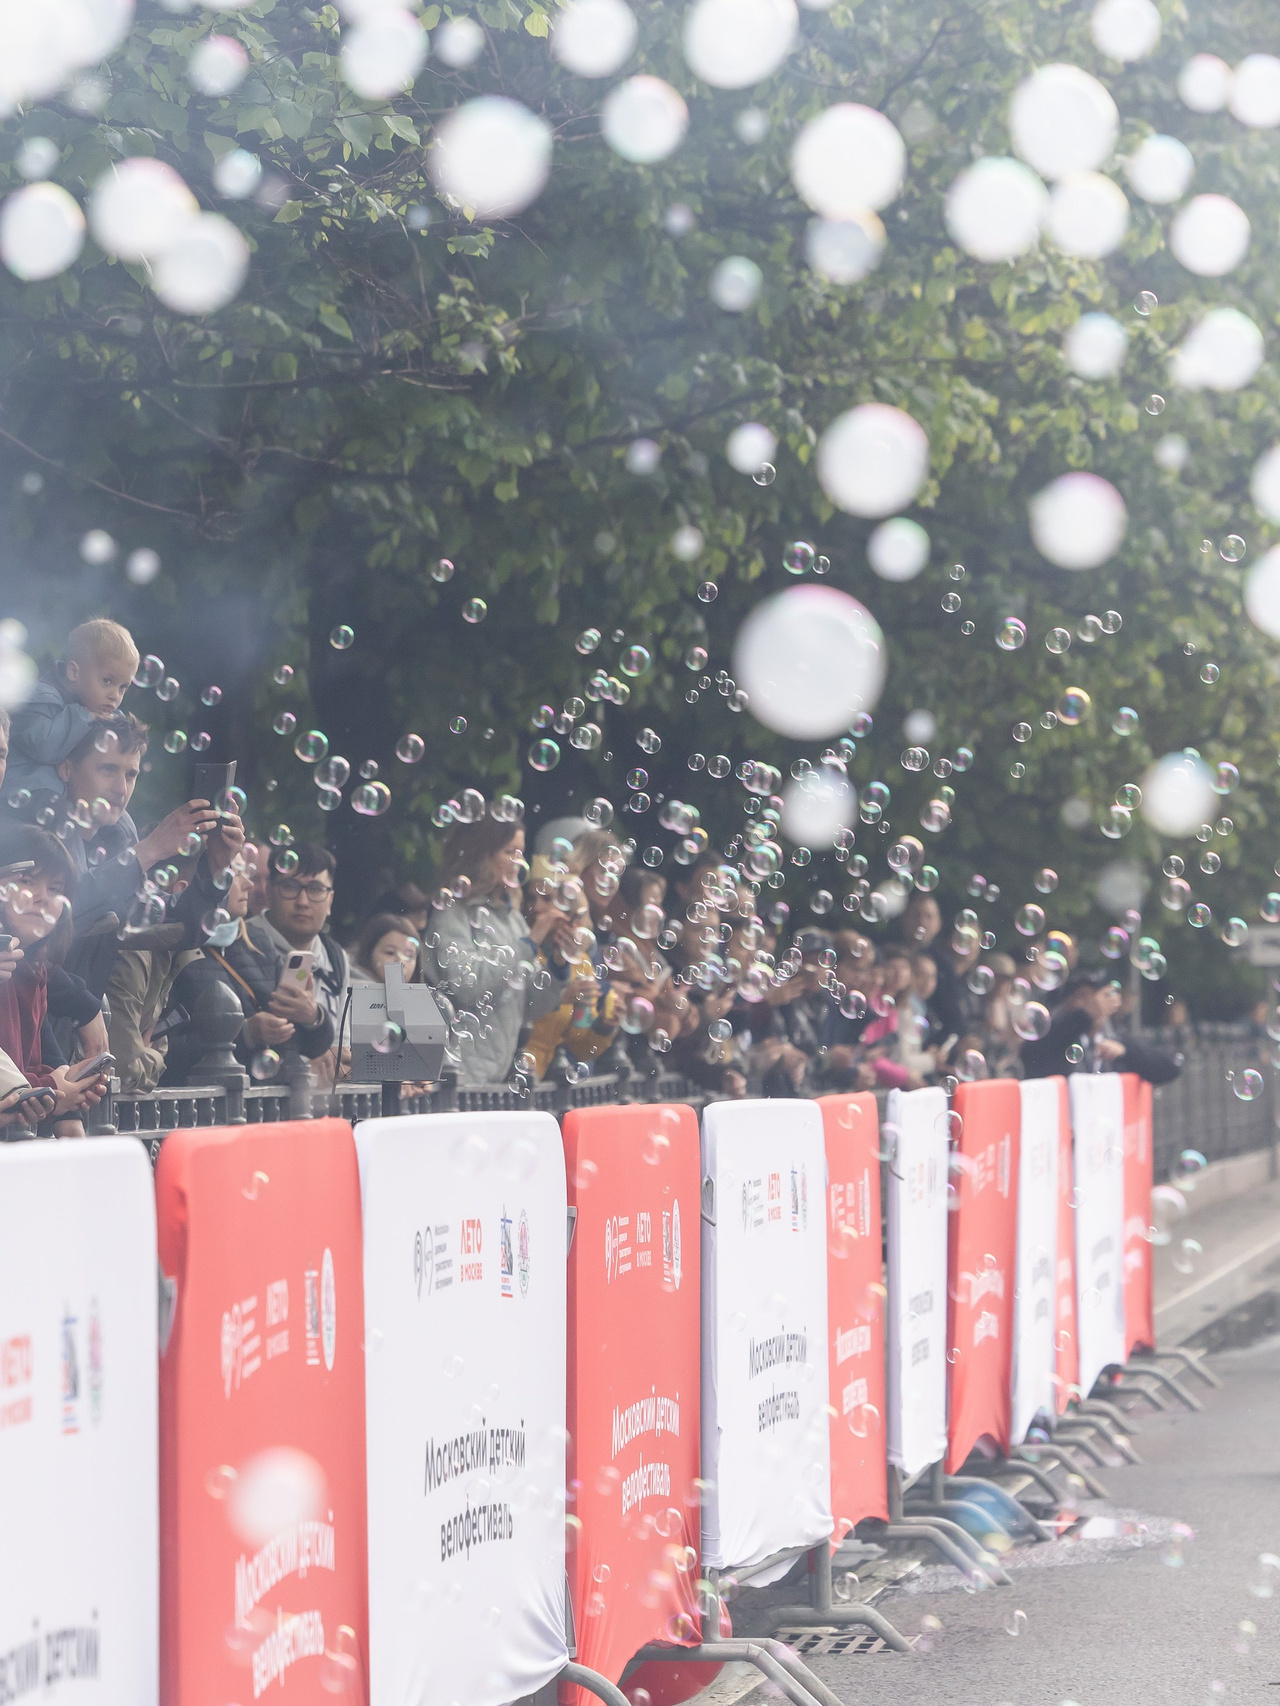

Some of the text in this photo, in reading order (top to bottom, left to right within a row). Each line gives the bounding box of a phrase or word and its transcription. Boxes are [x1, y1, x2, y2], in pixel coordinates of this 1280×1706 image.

[460, 1218, 482, 1255] ЛЕТО
[424, 1416, 526, 1497] Московский детский
[440, 1493, 513, 1563] велофестиваль
